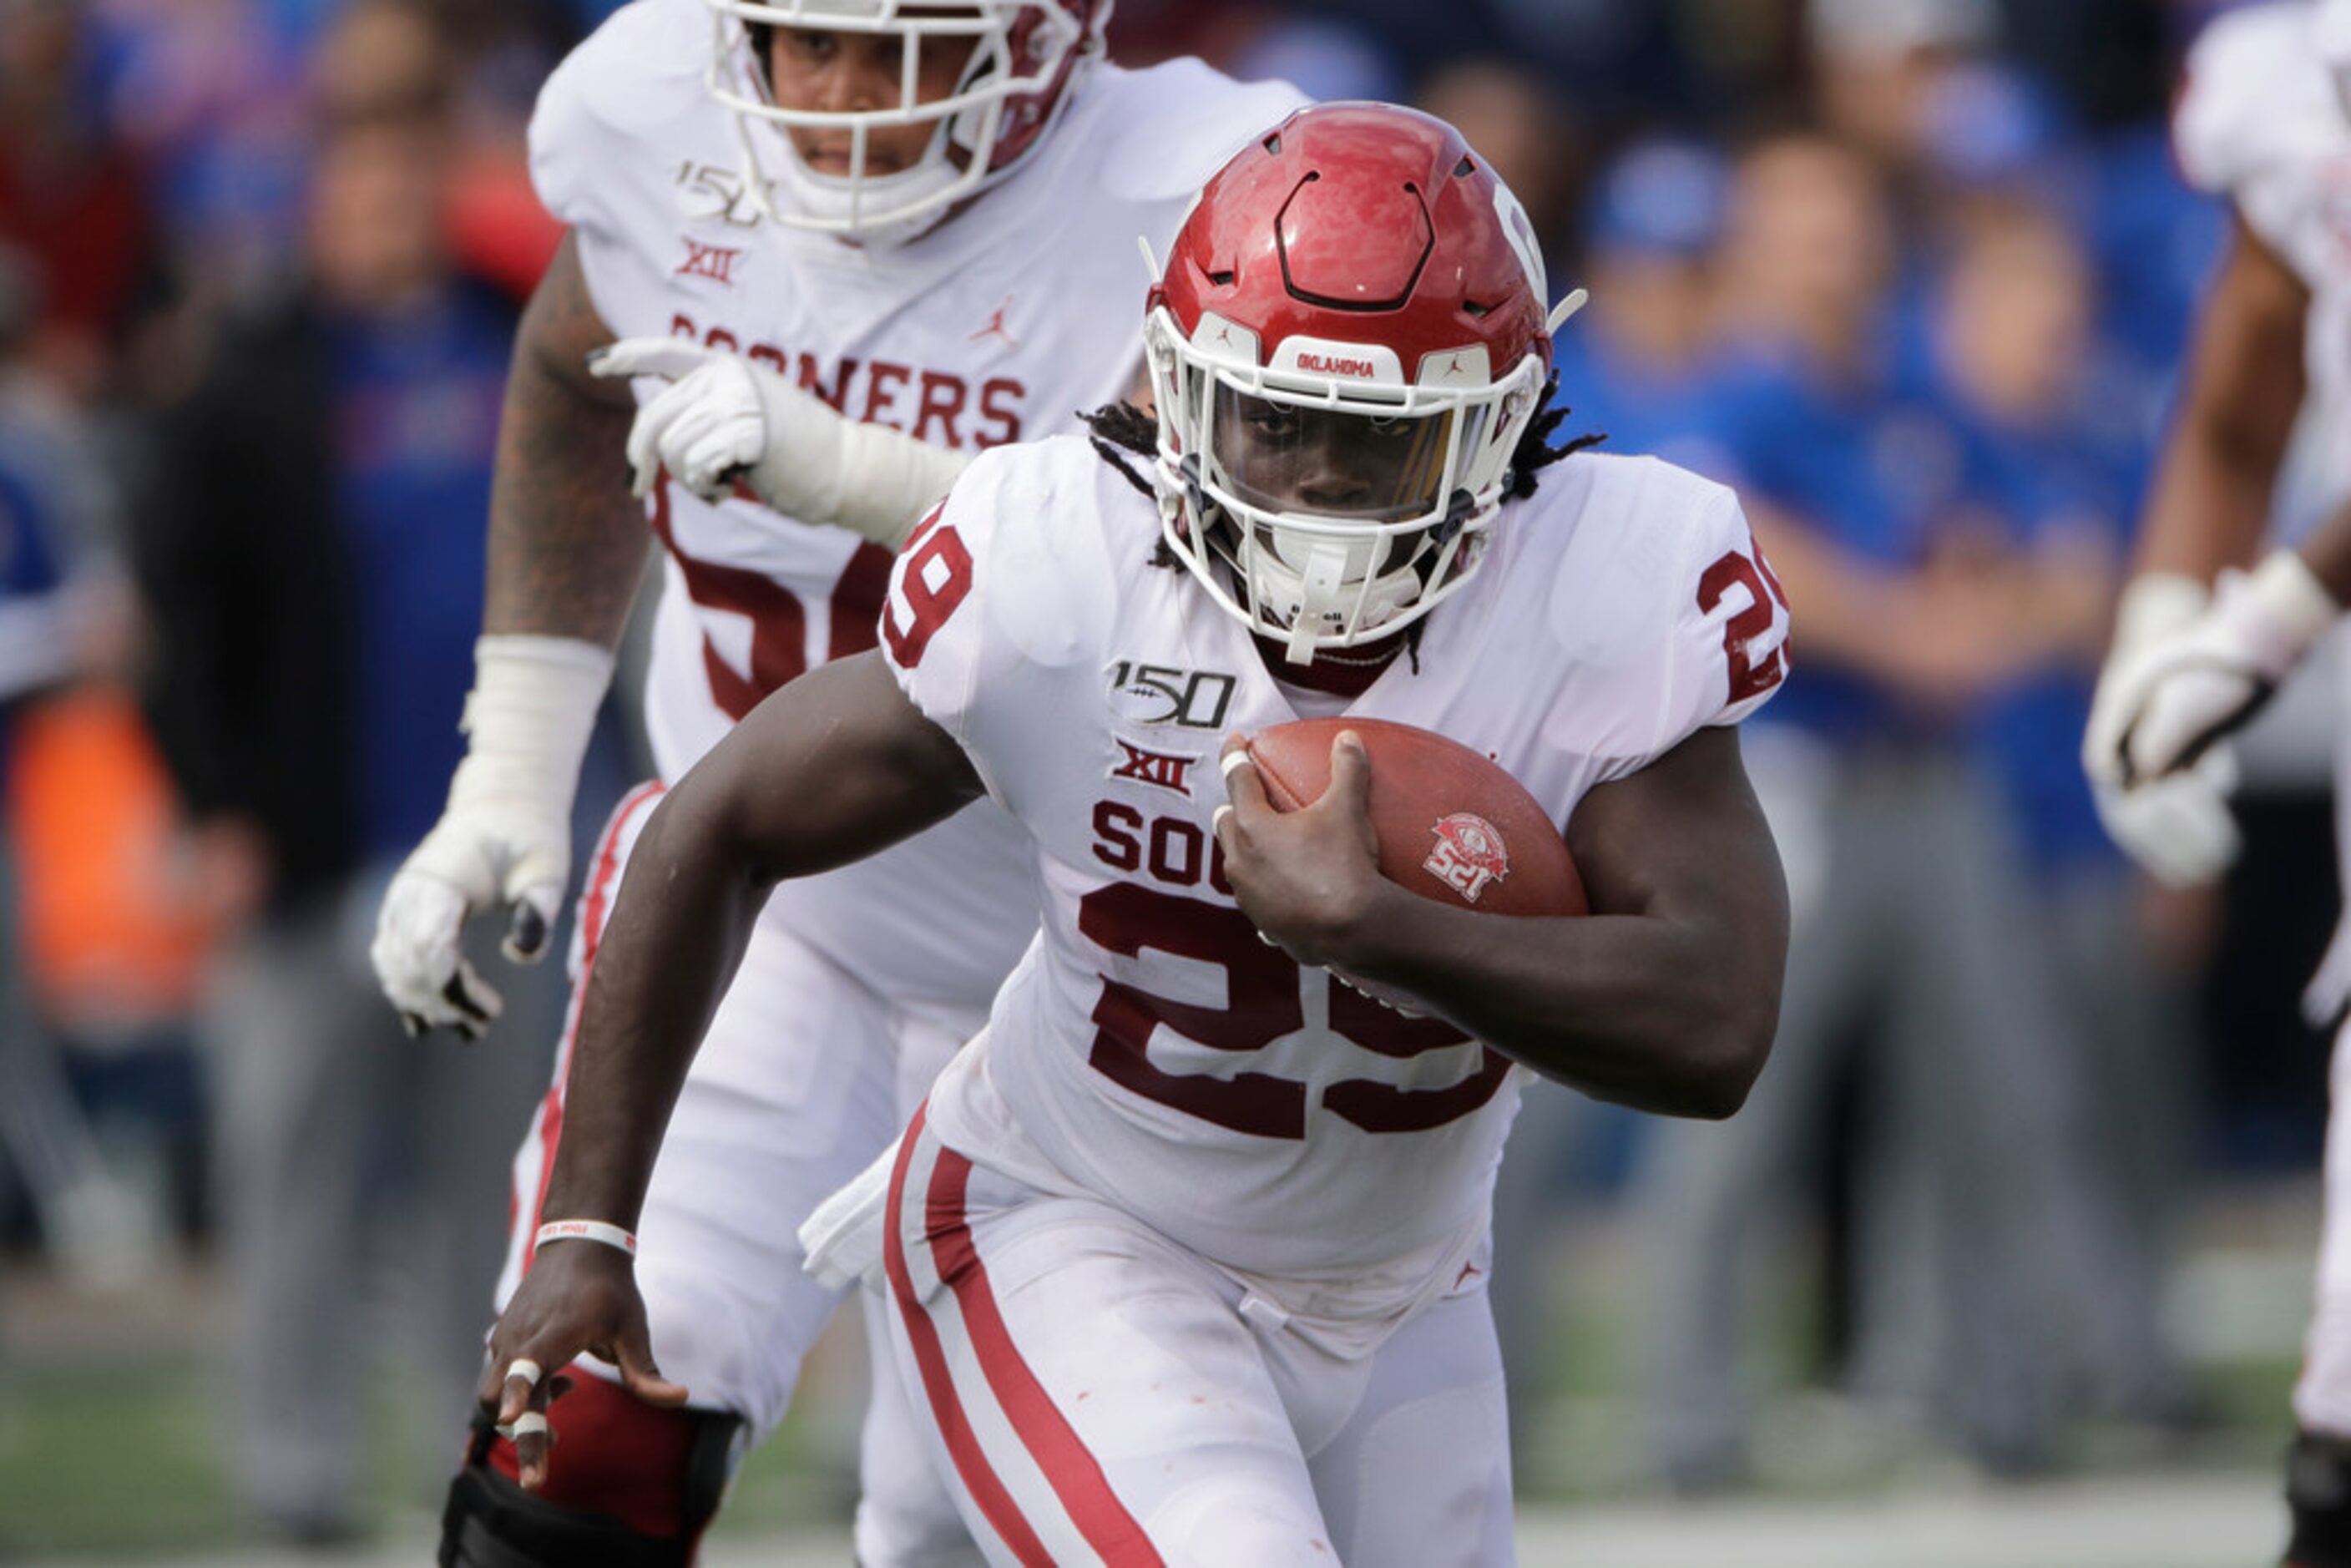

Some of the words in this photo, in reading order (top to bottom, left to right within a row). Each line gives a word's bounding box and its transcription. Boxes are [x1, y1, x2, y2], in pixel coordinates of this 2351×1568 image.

[1297, 352, 1375, 378] OKLAHOMA
[883, 494, 973, 669] 9
[1697, 534, 1790, 706] 2
[1110, 661, 1236, 728] 150
[1113, 737, 1195, 797] XII
